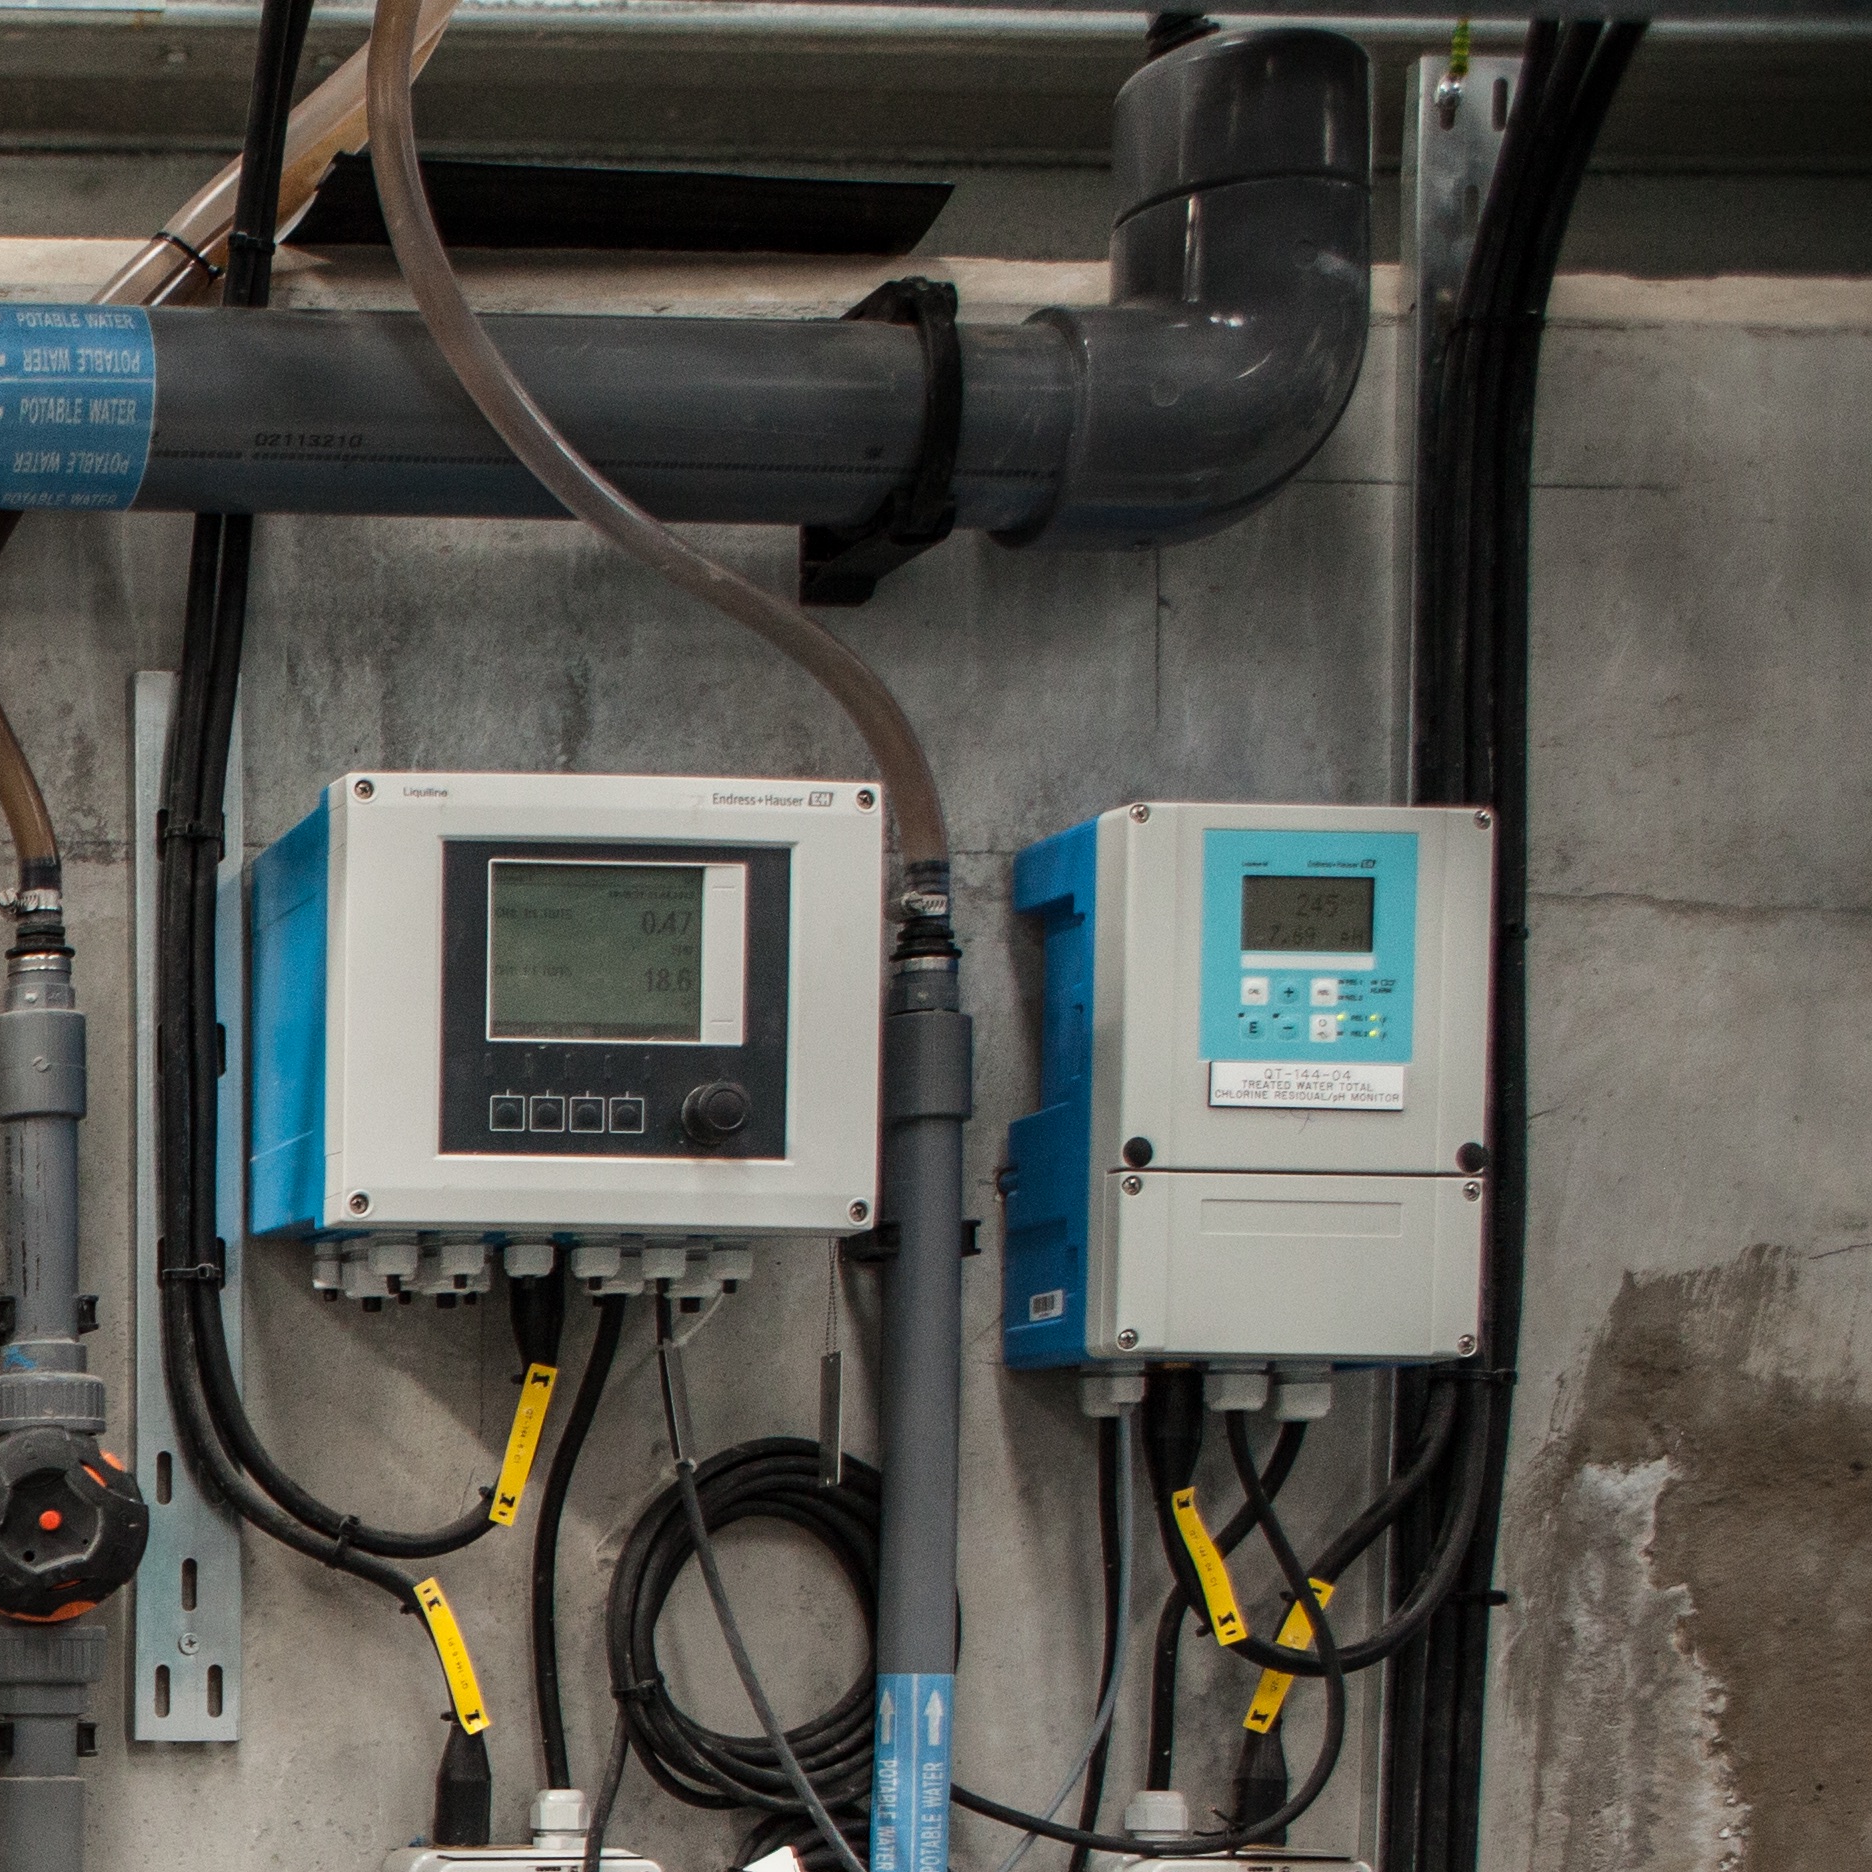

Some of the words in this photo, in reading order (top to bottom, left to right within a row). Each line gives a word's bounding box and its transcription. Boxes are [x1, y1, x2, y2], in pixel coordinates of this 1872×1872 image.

[17, 313, 81, 328] POTABLE
[85, 312, 135, 329] WATER
[23, 348, 70, 373] WATER
[78, 348, 140, 373] POTABLE
[20, 398, 82, 423] POTABLE
[89, 399, 136, 424] WATER
[712, 793, 804, 808] Endress+Hauser
[1242, 1079, 1291, 1090] TREATED
[1296, 1081, 1334, 1092] WATER
[1339, 1082, 1374, 1093] TOTAL
[1264, 1067, 1352, 1081] QT-144-04
[1214, 1089, 1268, 1100] CHLORINE
[1350, 1092, 1400, 1103] MONITOR
[877, 1760, 898, 1820] POTABLE
[922, 1761, 944, 1809] WATER
[875, 1825, 897, 1872] WATER
